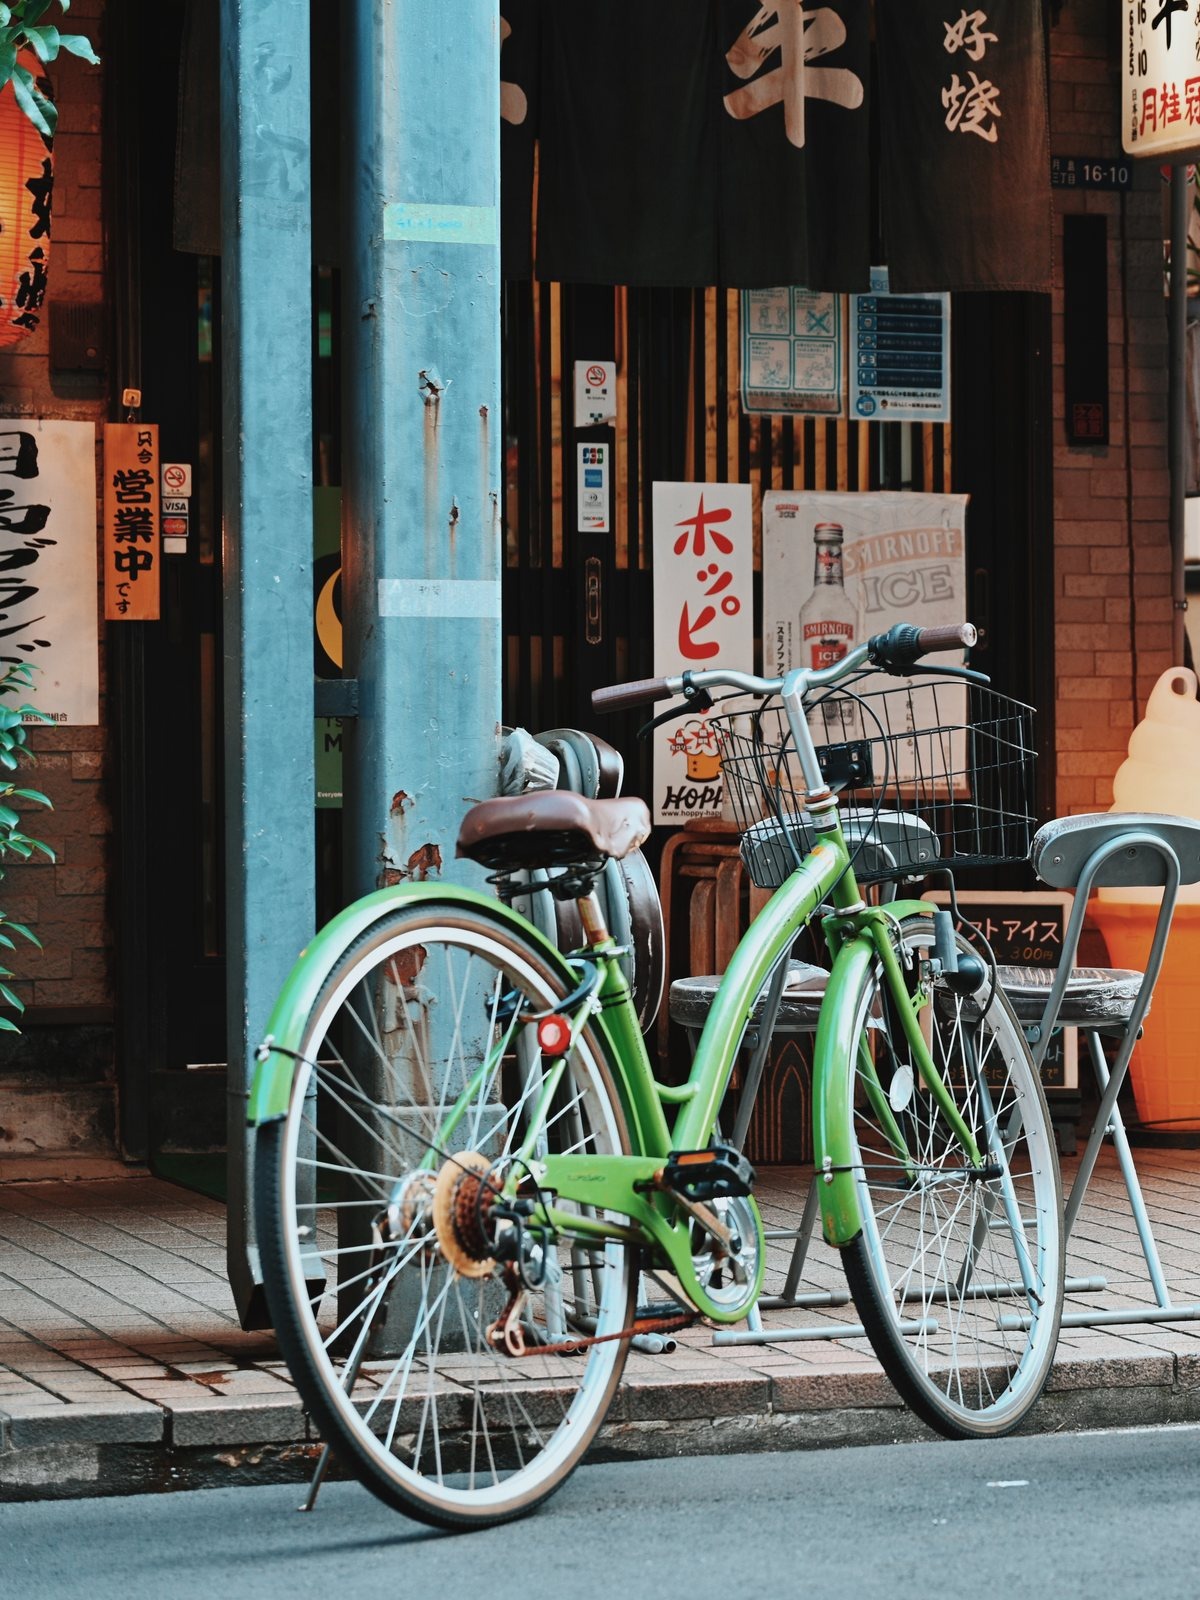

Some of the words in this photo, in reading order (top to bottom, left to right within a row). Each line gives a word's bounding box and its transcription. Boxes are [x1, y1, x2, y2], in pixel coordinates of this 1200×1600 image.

[1052, 172, 1077, 185] 三丁目
[1083, 164, 1128, 184] 16-10
[165, 502, 187, 511] VISA
[844, 530, 956, 573] SMIRNOFF
[862, 564, 955, 614] ICE
[805, 622, 852, 638] SMIRNOFF
[777, 626, 785, 660] スミノフ
[818, 651, 840, 661] ICE
